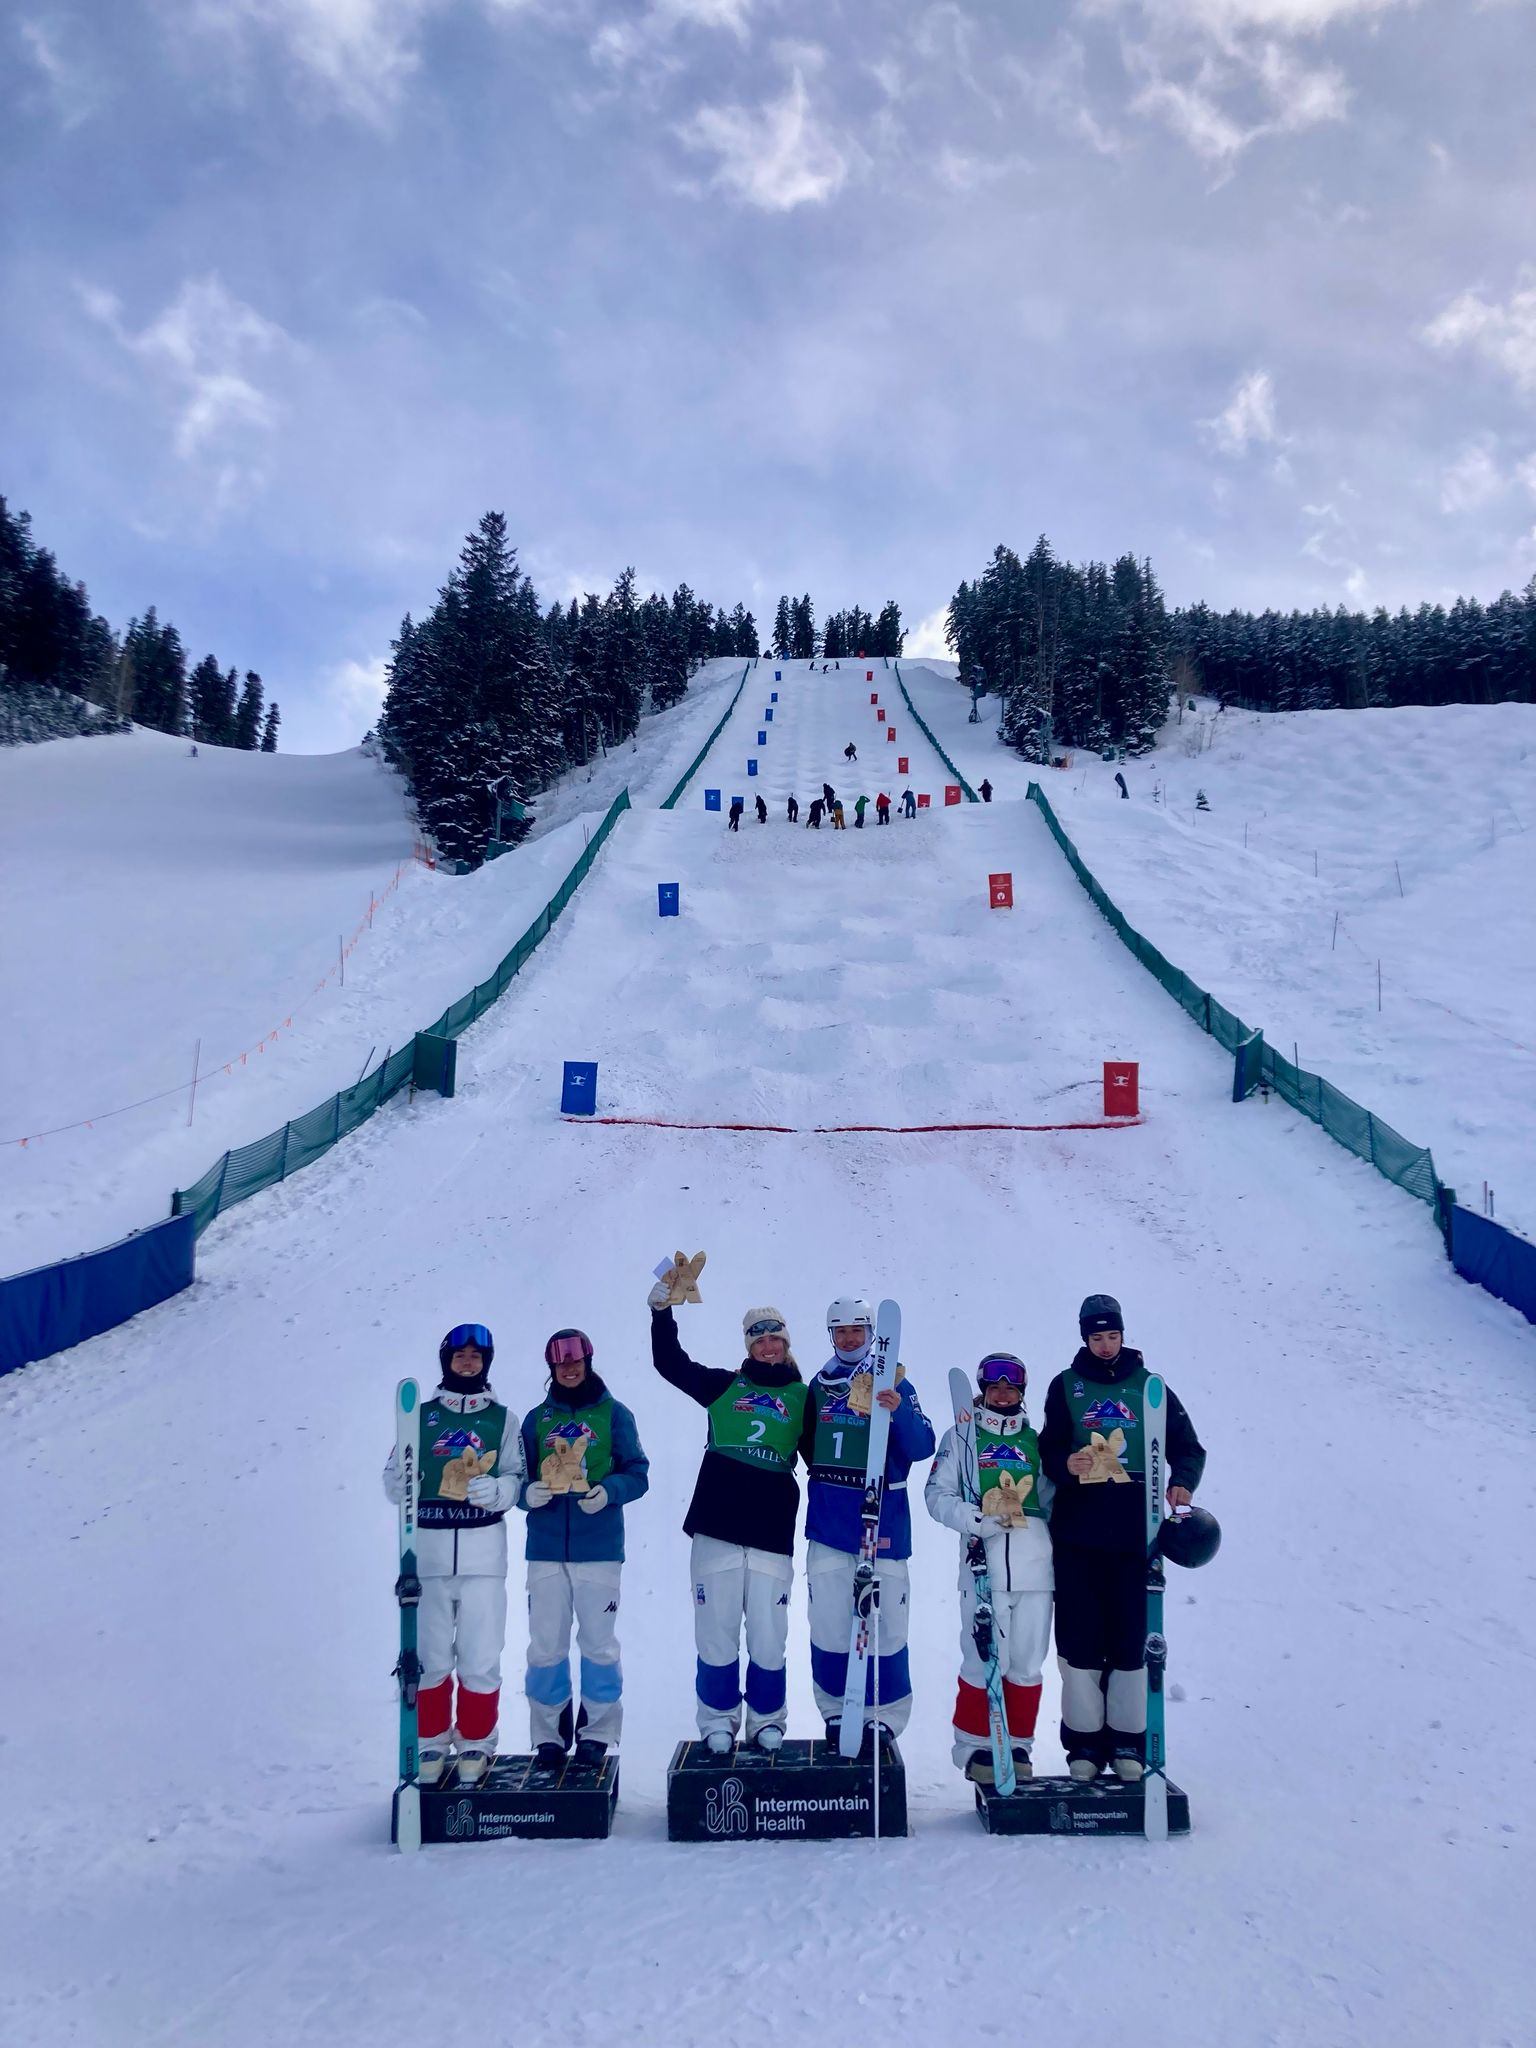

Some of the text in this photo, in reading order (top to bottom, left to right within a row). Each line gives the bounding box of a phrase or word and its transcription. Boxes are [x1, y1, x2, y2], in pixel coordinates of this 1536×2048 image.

[746, 1420, 766, 1443] 2
[832, 1431, 844, 1459] 1
[755, 1795, 870, 1813] Intermountain
[478, 1812, 555, 1823] Intermountain
[1072, 1811, 1128, 1820] Intermountain
[478, 1824, 512, 1835] Health
[755, 1815, 806, 1832] Health
[1073, 1820, 1099, 1829] Health
